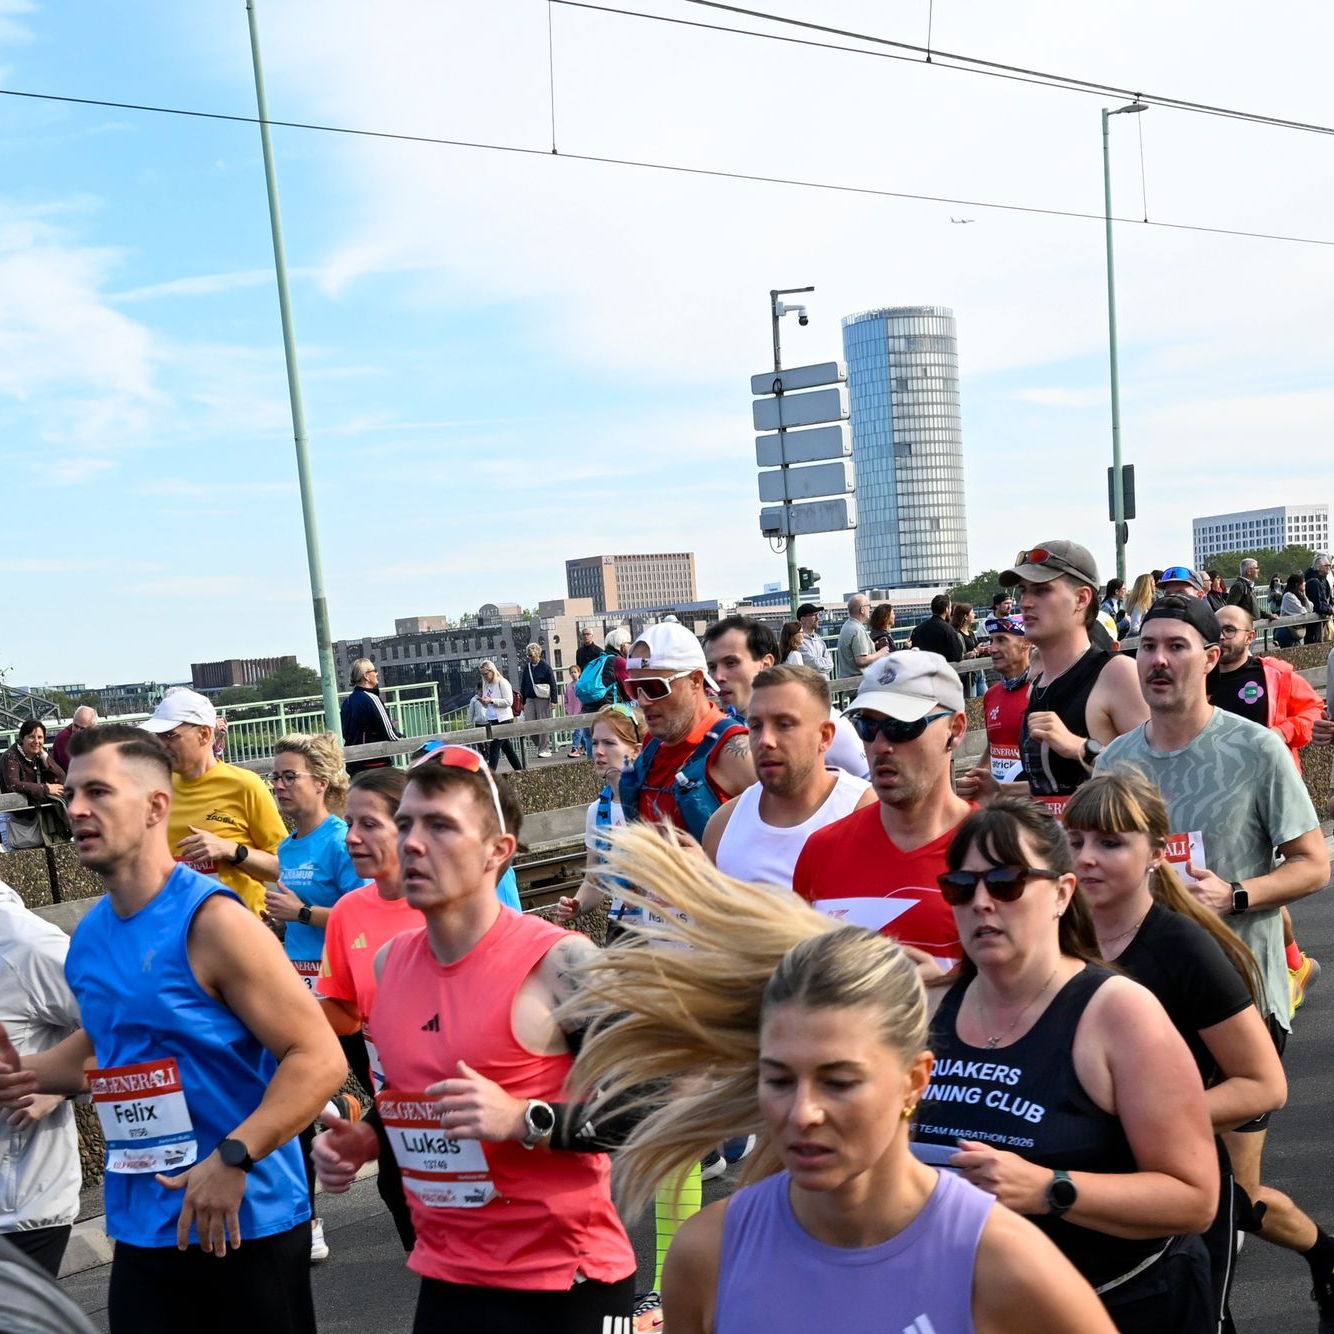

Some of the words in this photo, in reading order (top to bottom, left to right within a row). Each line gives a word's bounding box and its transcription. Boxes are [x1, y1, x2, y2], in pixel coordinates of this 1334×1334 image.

[991, 758, 1015, 770] atrick
[113, 1102, 159, 1124] Felix
[985, 1090, 1045, 1123] CLUB
[401, 1131, 461, 1154] Lukas
[919, 1123, 948, 1136] TEAM
[948, 1128, 1008, 1144] MARATHON
[1007, 1135, 1035, 1148] 2026
